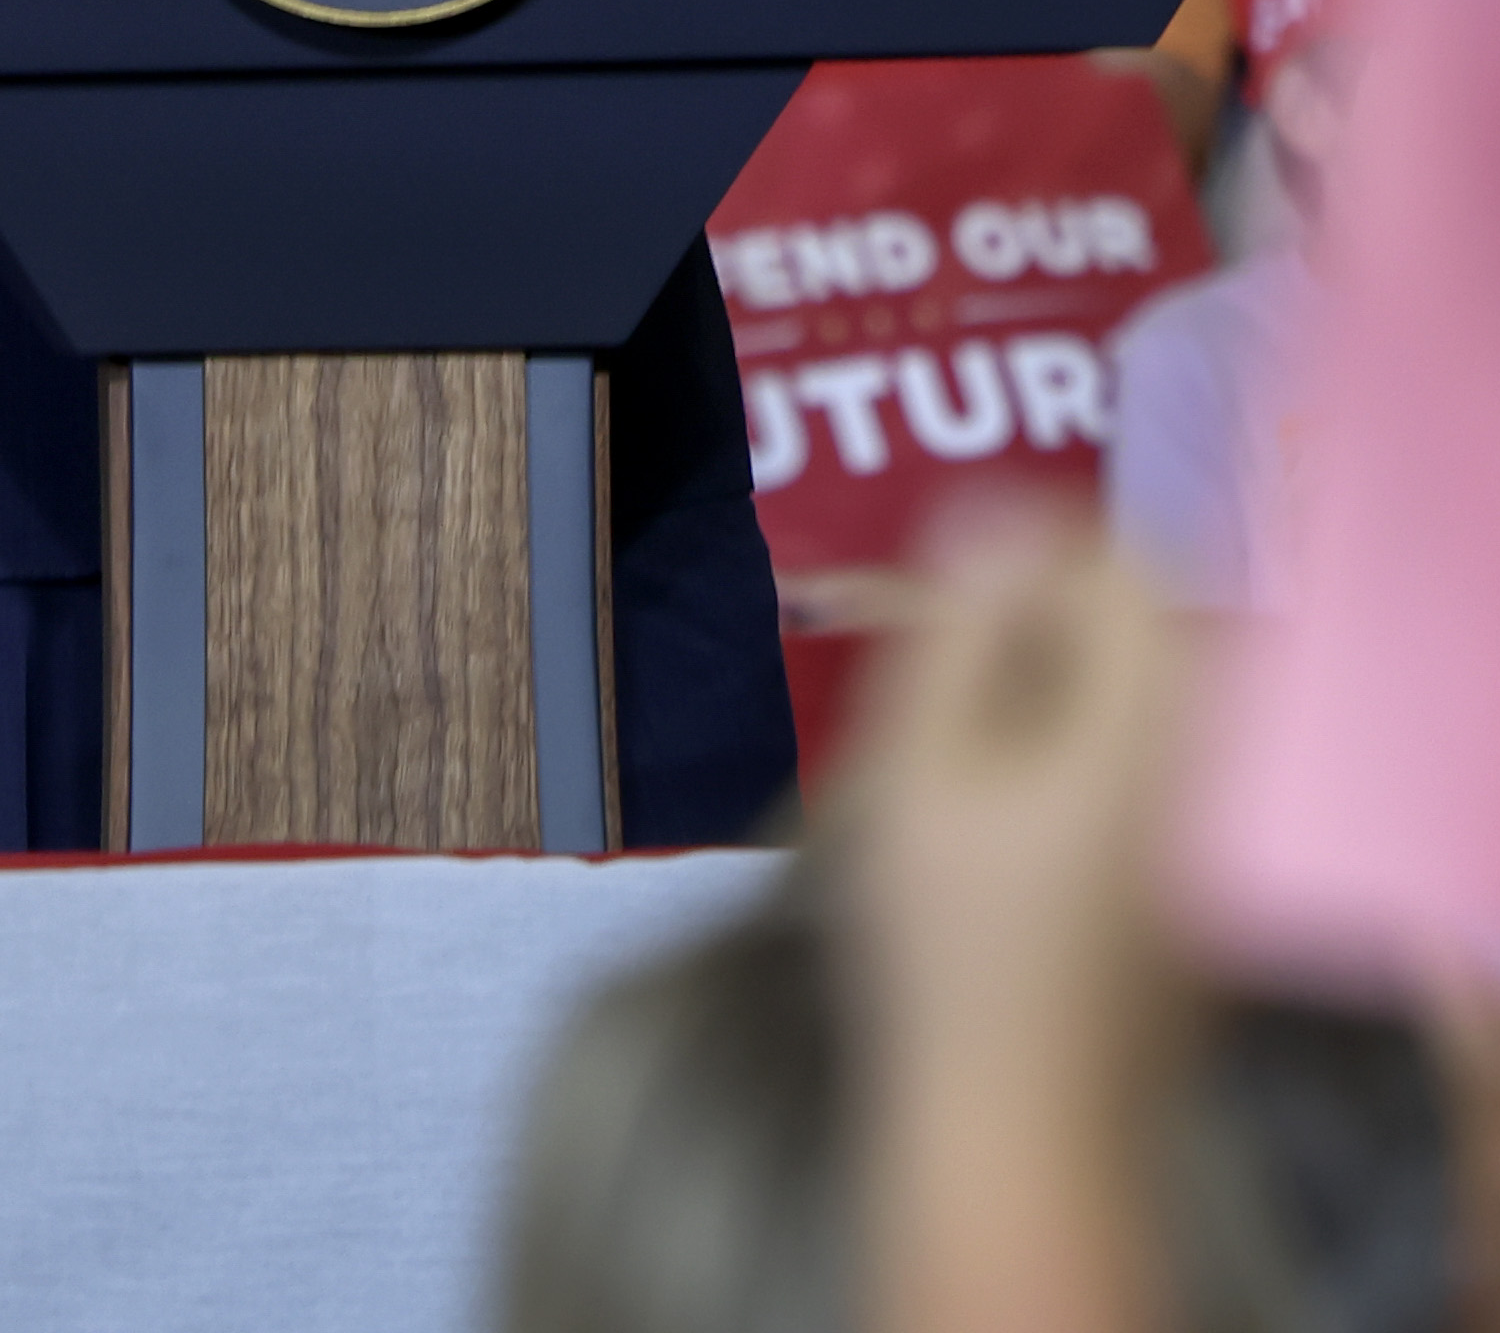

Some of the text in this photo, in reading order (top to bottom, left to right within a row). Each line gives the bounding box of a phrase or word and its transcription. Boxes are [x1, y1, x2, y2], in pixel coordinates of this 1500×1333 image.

[708, 195, 1157, 310] END OUR
[743, 328, 1118, 495] UTUR
